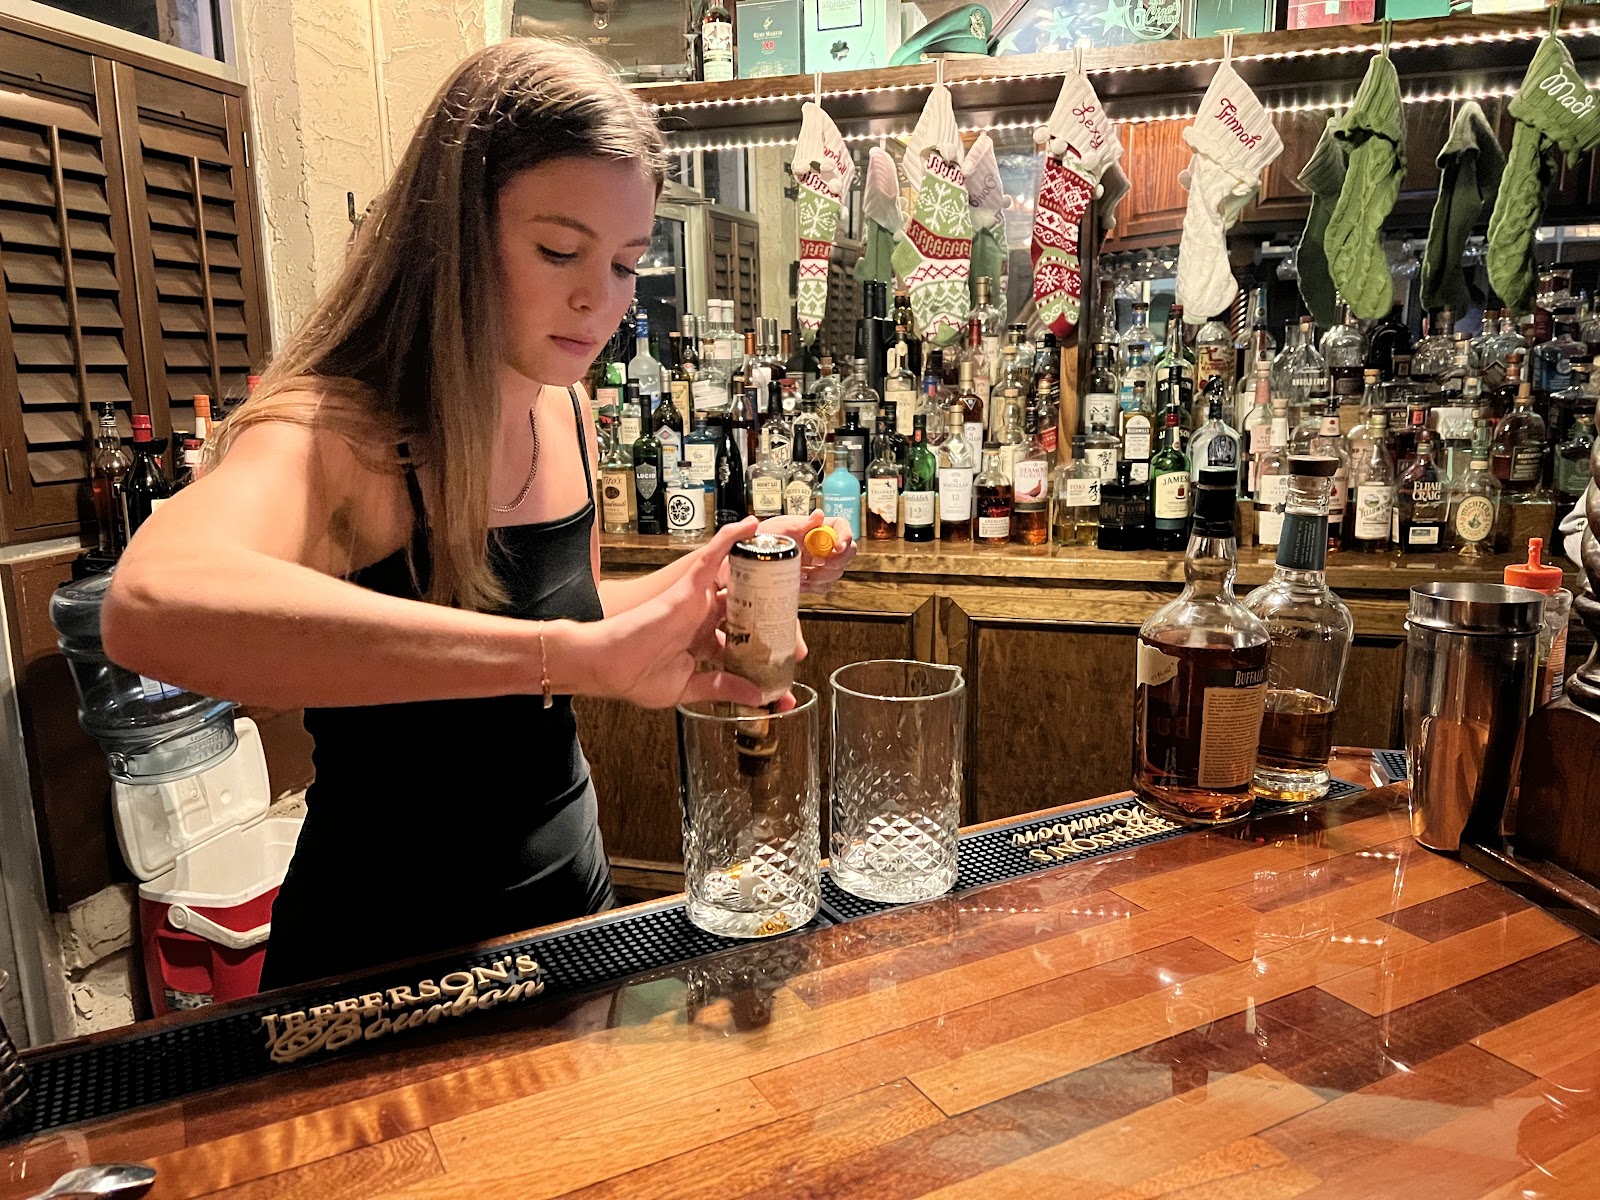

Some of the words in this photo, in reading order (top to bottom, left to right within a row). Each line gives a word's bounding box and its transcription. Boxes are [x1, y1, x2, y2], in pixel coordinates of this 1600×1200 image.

[762, 40, 775, 50] XO
[1538, 67, 1594, 119] Madi
[1072, 102, 1104, 150] Lexy
[1213, 98, 1262, 150] Trinnah
[1162, 476, 1188, 486] JAMES
[1412, 490, 1440, 502] CRAIG
[1414, 481, 1442, 491] ELIJAH
[1235, 668, 1264, 686] BUFFALO
[261, 954, 539, 1050] JEFFERSON'S
[269, 980, 545, 1064] Bourbon
